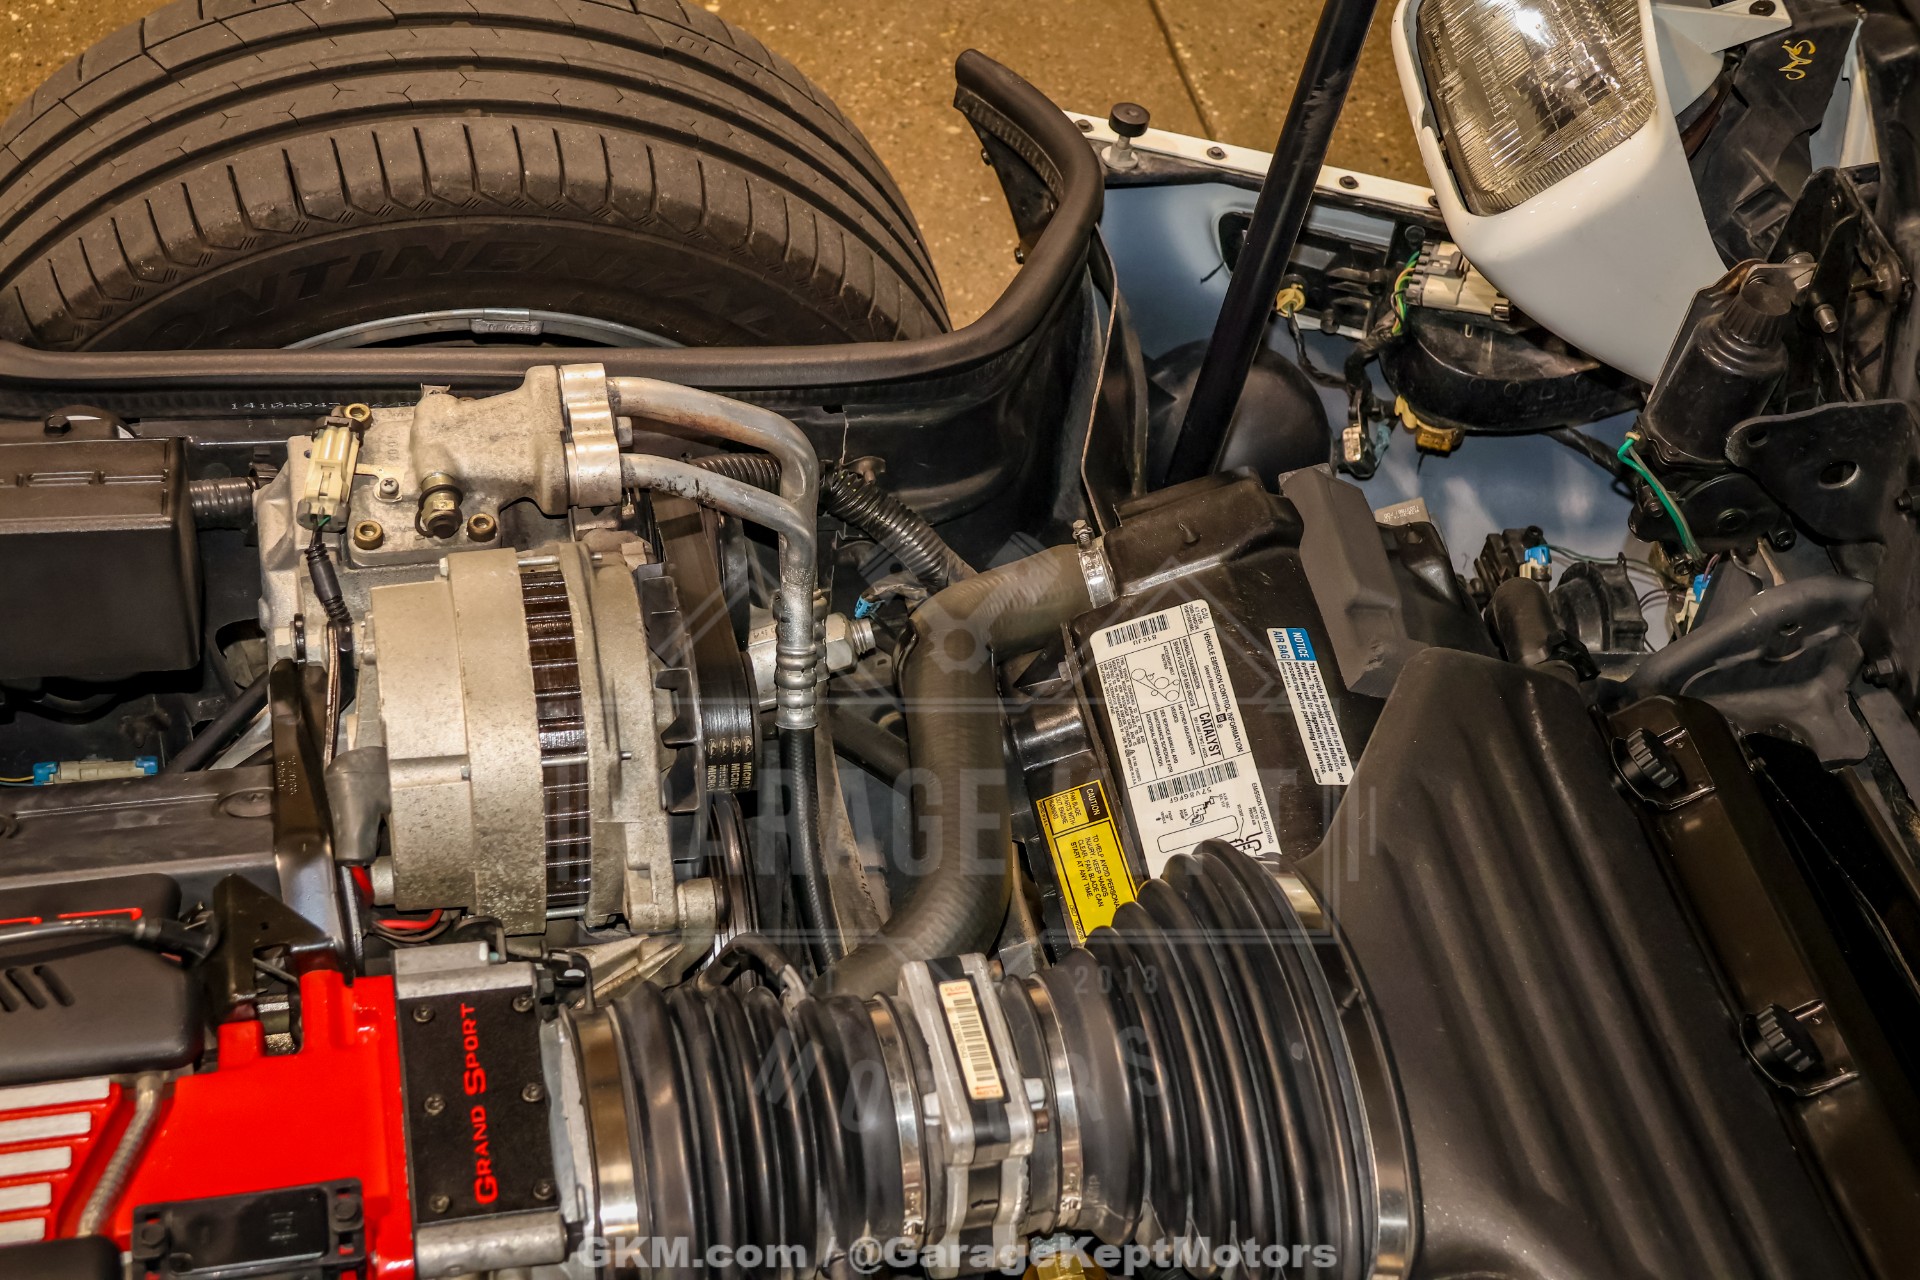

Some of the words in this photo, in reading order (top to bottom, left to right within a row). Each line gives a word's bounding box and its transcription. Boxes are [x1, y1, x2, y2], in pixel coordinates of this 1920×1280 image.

[1272, 628, 1284, 644] AIR
[1291, 629, 1310, 660] NOTICE
[1276, 642, 1290, 661] BAG
[1284, 659, 1301, 692] procedures
[1292, 660, 1304, 680] service
[1308, 661, 1317, 674] This
[1202, 631, 1215, 656] VEHICLE
[1209, 655, 1224, 684] EMISSION
[1217, 682, 1232, 712] CONTROL
[1226, 711, 1243, 753] INFORMATION
[1300, 680, 1311, 702] manual
[1308, 682, 1315, 690] To
[1312, 673, 1323, 694] vehicle
[1295, 691, 1307, 710] before
[1309, 689, 1319, 704] help
[1306, 701, 1314, 711] for
[1314, 702, 1325, 719] avoid
[1319, 699, 1334, 727] equipped
[1300, 708, 1316, 741] performing
[1308, 710, 1324, 740] diagnostic
[1329, 725, 1338, 738] with
[1198, 711, 1221, 758] CATALYST
[1333, 738, 1340, 747] an
[1310, 740, 1319, 752] any
[1319, 738, 1327, 751] and
[1336, 745, 1344, 755] air
[1322, 750, 1335, 773] service
[1337, 754, 1347, 767] bag
[1068, 790, 1077, 801] FAN
[1085, 787, 1101, 816] CAUTION
[1071, 800, 1081, 817] BLADE
[1091, 833, 1099, 843] TO
[1069, 840, 1080, 859] START
[1094, 842, 1104, 858] HELP
[1075, 859, 1083, 868] AT
[1083, 859, 1092, 872] FAN
[1099, 858, 1111, 877] AVOID
[1078, 868, 1088, 882] ANY
[1087, 872, 1099, 893] BLADE
[1091, 858, 1101, 875] KEEP
[1096, 874, 1109, 898] HANDS
[1082, 882, 1093, 899] TIME.
[1105, 877, 1122, 912] PERSONA
[1094, 892, 1104, 908] CAN
